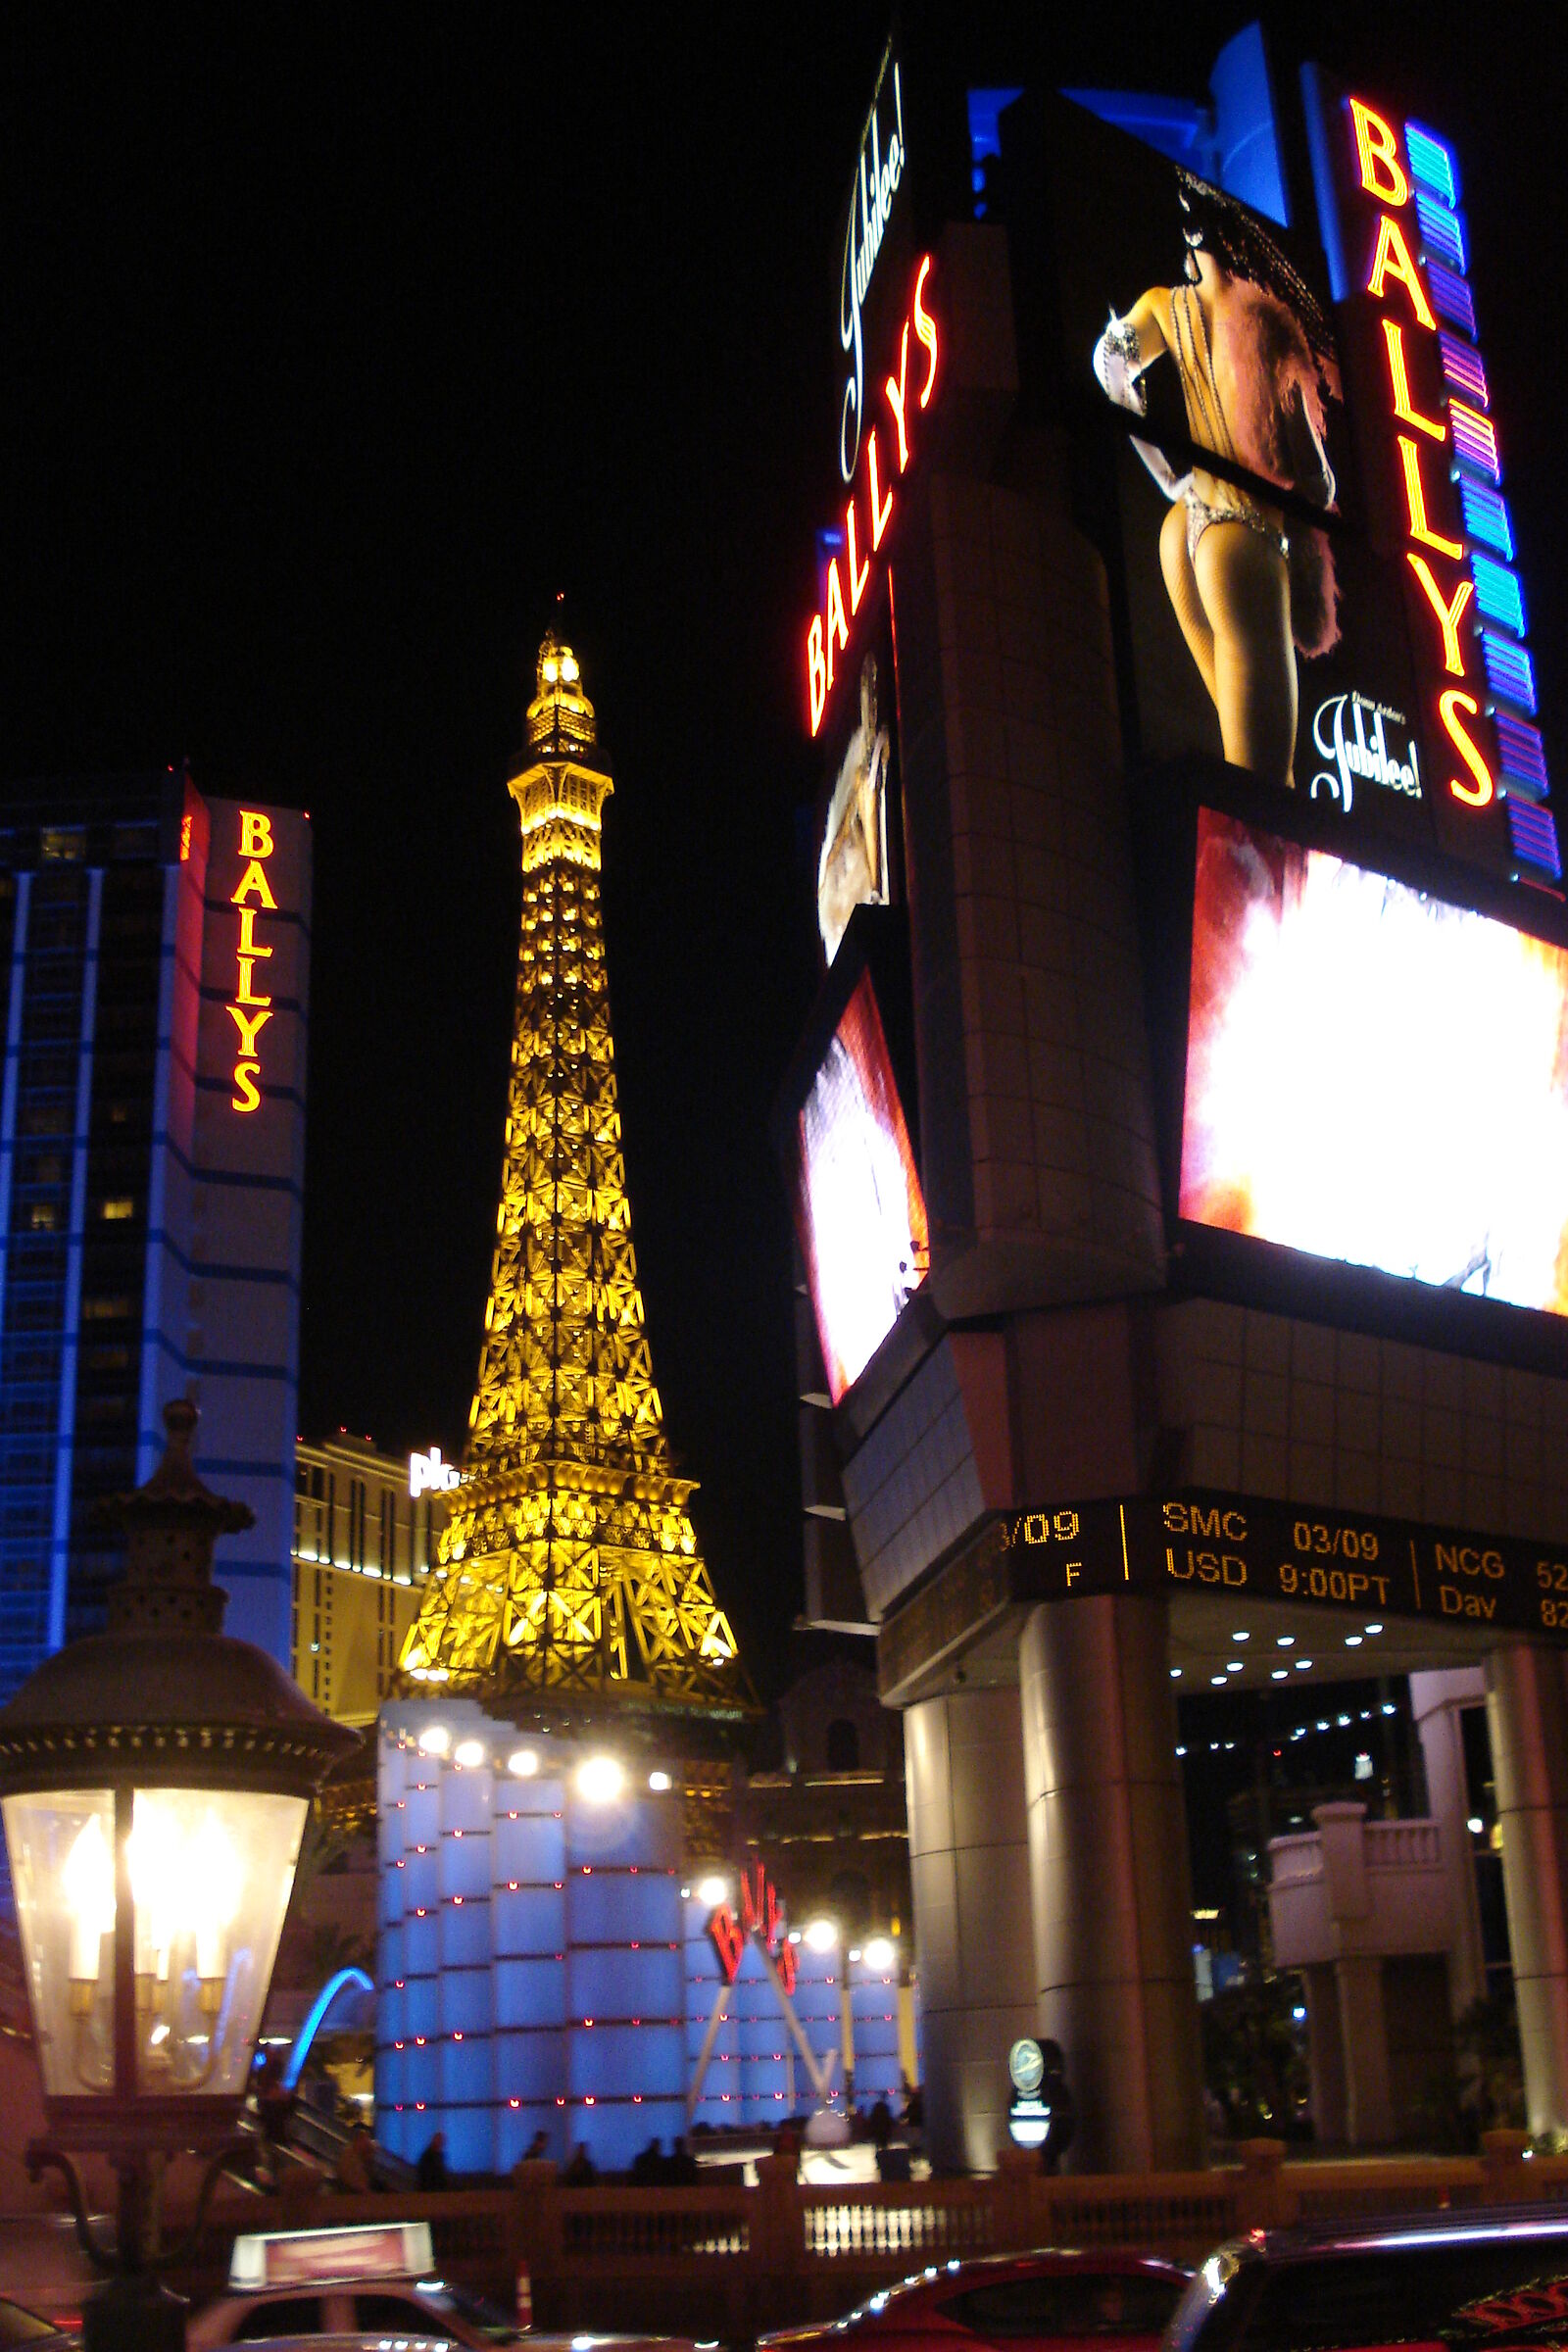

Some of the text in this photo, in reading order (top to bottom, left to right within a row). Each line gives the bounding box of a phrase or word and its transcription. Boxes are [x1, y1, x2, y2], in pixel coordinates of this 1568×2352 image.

[1310, 694, 1422, 812] Jubilee!
[1163, 1501, 1379, 1561] SMC 03/09
[1065, 1561, 1082, 1587] F
[1166, 1547, 1248, 1587] USD
[1435, 1543, 1505, 1579] NCG
